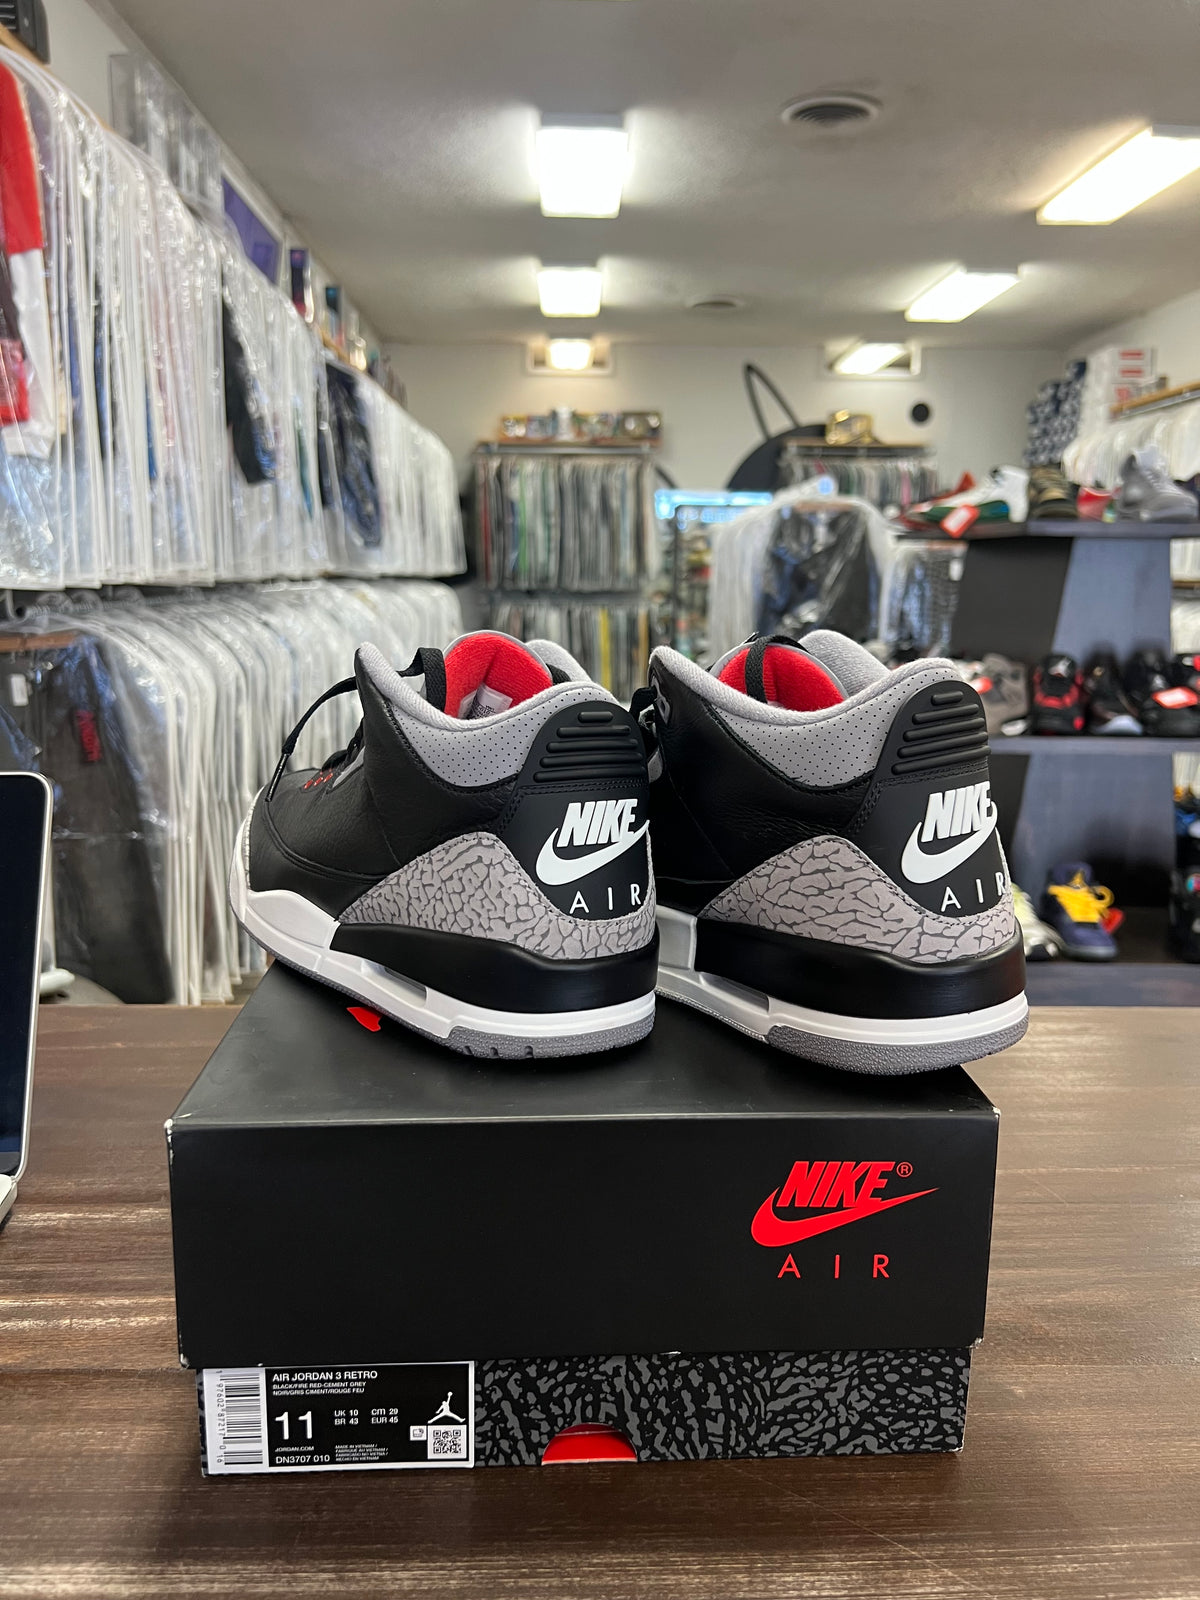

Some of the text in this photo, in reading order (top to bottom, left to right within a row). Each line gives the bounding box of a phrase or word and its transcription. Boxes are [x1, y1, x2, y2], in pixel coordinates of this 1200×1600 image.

[556, 798, 638, 848] NIKE
[920, 780, 991, 843] NIKE
[569, 883, 641, 914] AIR
[940, 871, 1005, 912] AIR
[775, 1160, 896, 1208] NIKE
[777, 1253, 890, 1279] AIR
[272, 1370, 378, 1382] AIR JORDAN 3 RETRO
[334, 1409, 346, 1417] UK
[334, 1417, 359, 1426] BR 43
[371, 1416, 387, 1424] EUR
[388, 1407, 399, 1415] 29
[275, 1411, 312, 1439] 11
[275, 1454, 331, 1464] DN3707 010
